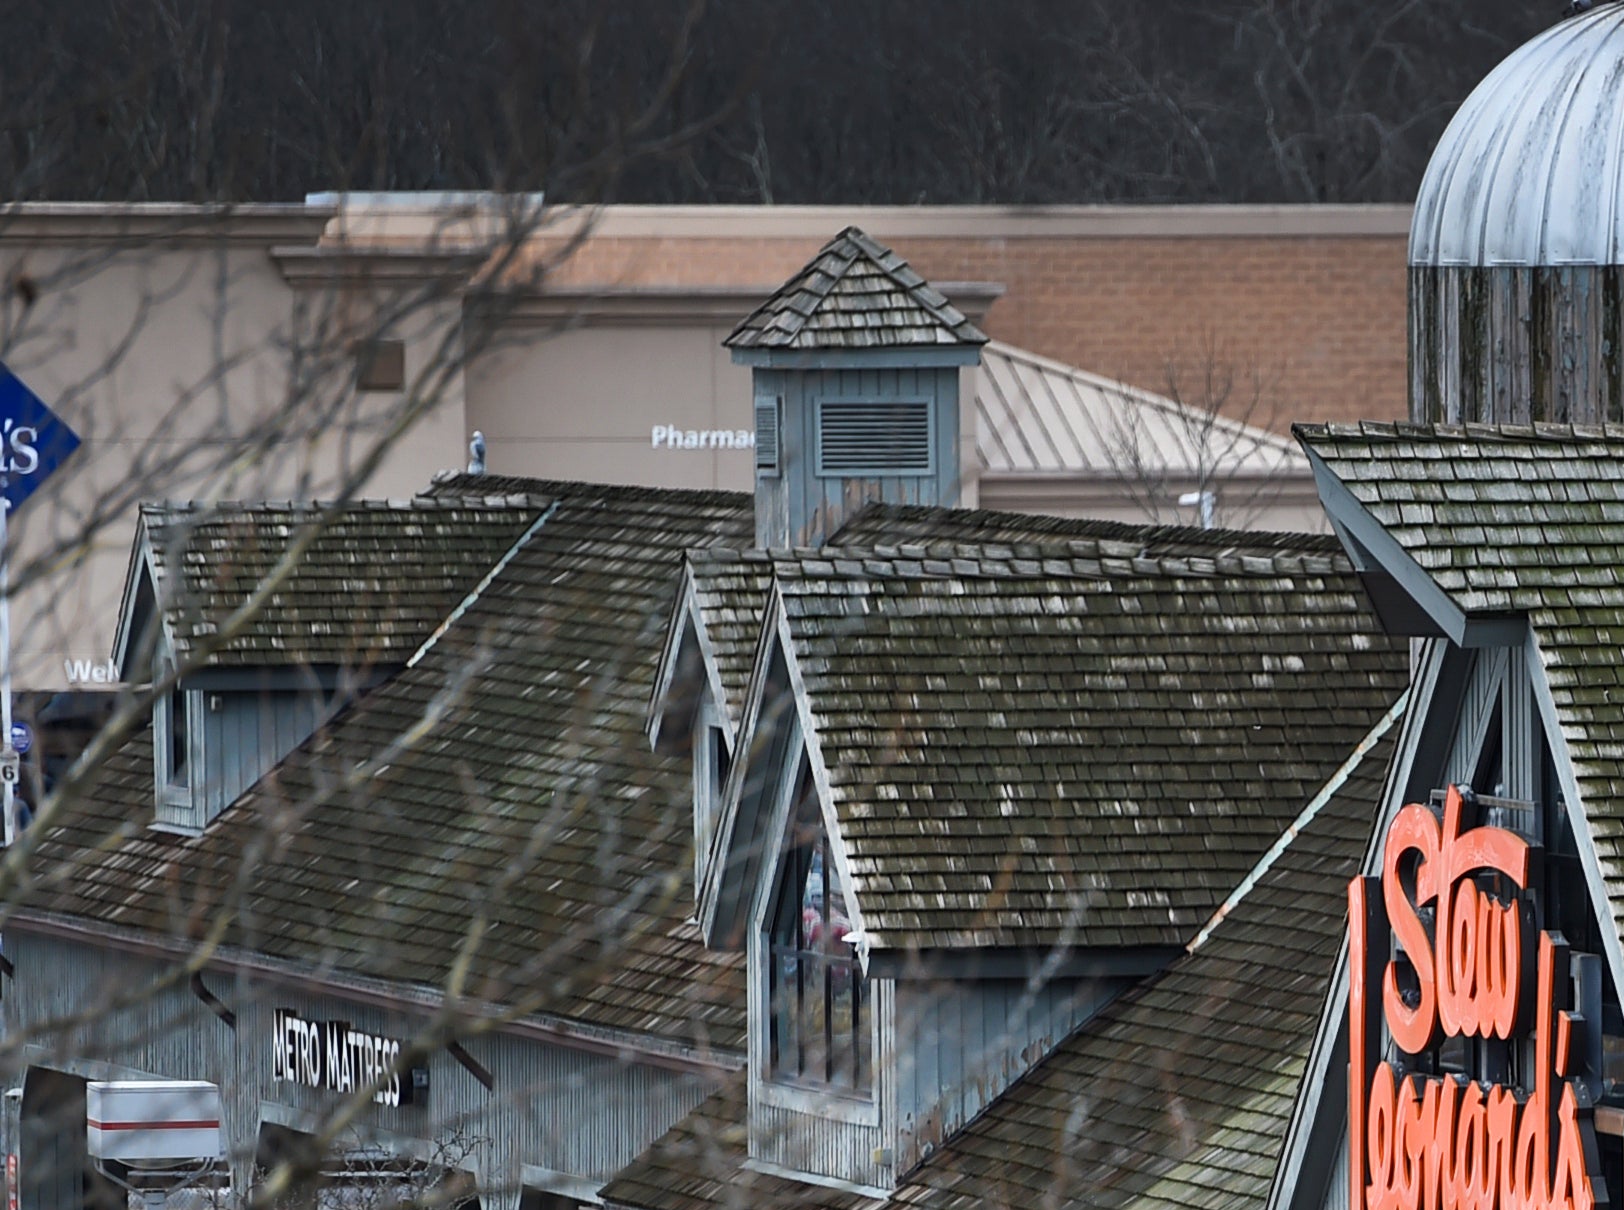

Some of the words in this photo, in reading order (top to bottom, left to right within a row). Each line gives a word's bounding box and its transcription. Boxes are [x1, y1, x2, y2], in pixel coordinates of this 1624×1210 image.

[2, 765, 15, 781] 6
[1383, 783, 1529, 1056] Stew
[273, 1008, 321, 1089] METRO
[326, 1020, 400, 1108] MATTRESS
